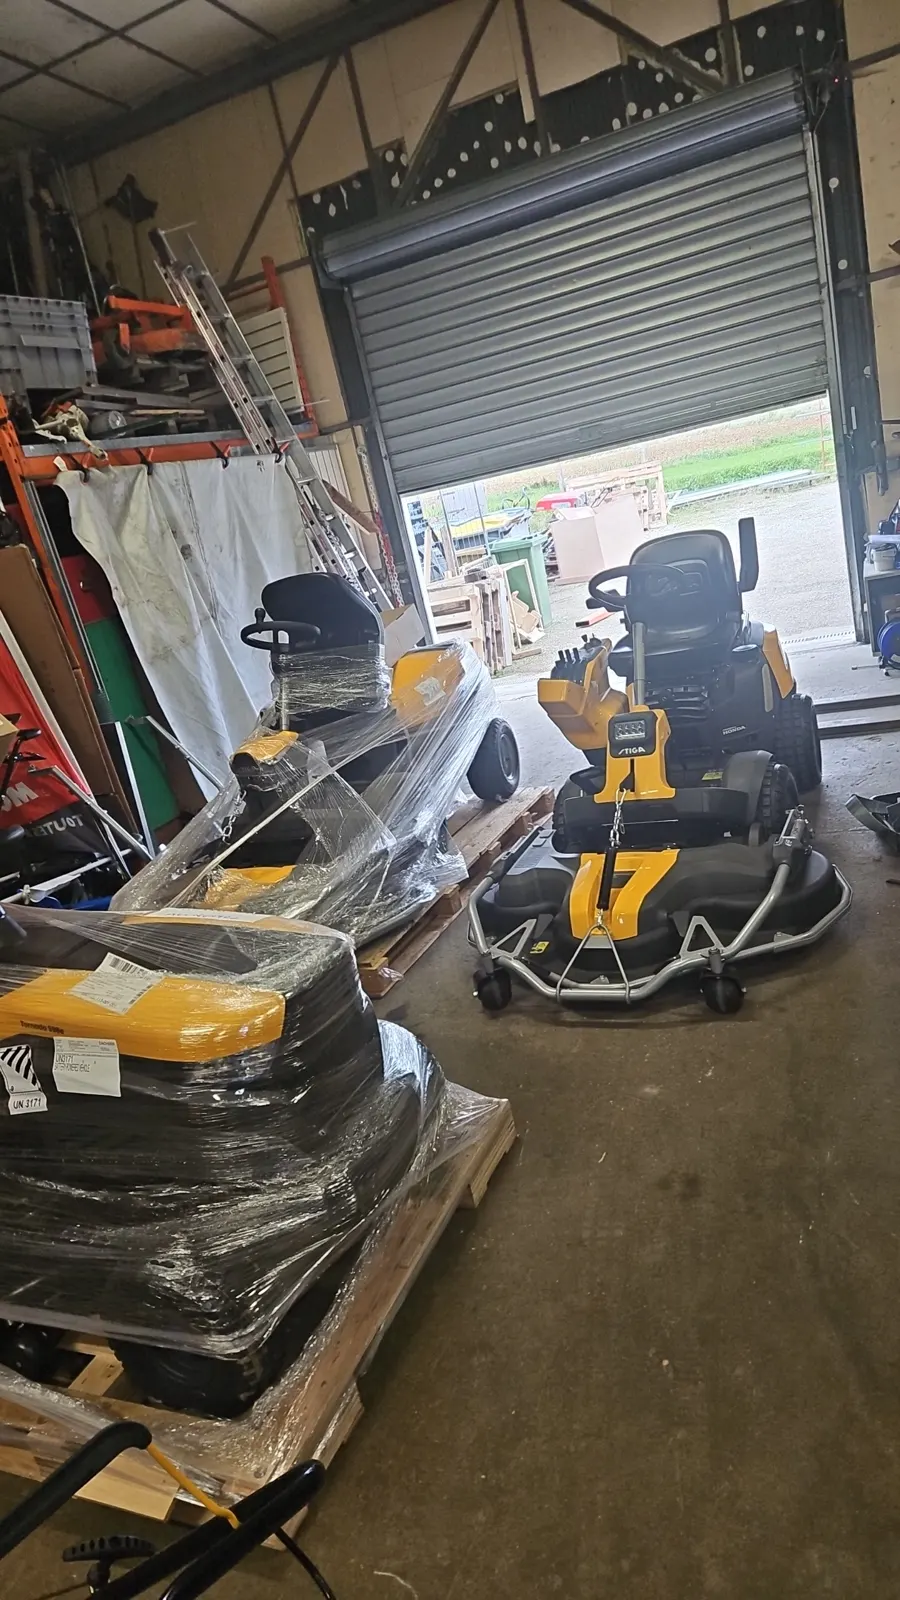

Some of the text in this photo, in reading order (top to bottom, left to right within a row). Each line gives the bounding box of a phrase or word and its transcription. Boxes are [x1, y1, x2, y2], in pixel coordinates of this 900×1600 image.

[722, 725, 746, 736] HONDA
[618, 746, 646, 755] STIGA
[13, 1097, 42, 1110] UN 3171
